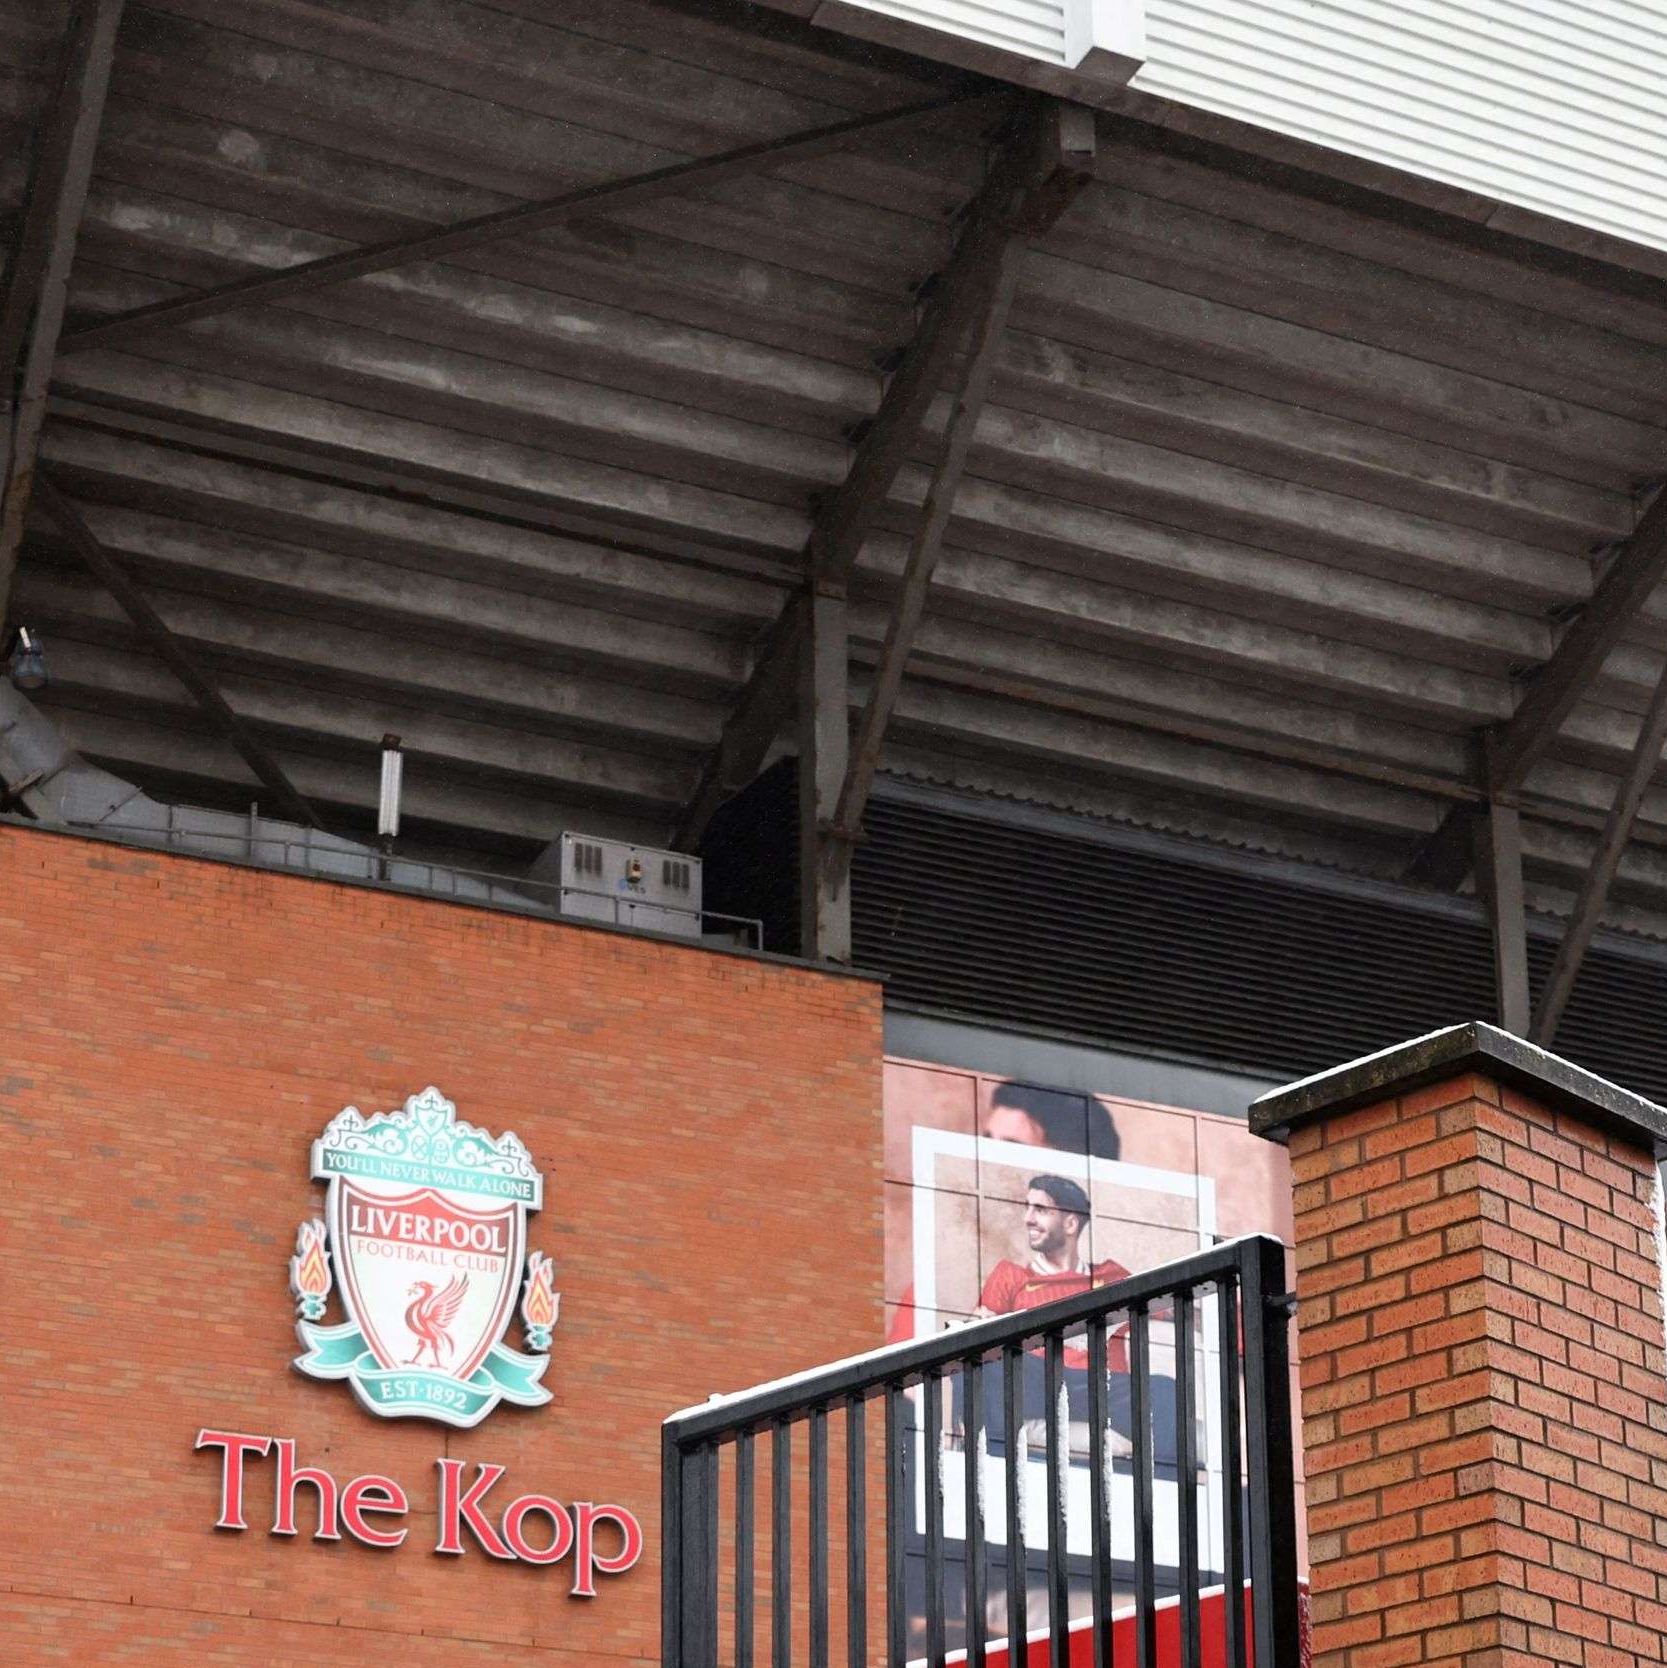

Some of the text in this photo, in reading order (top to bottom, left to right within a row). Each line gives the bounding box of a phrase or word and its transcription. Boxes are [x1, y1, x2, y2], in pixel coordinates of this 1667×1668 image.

[326, 1153, 532, 1198] YOU'LL NEVER WALK ALONE
[351, 1205, 507, 1253] LIVERPOOL
[357, 1240, 499, 1274] FOOTBALL CLUB
[195, 1428, 643, 1597] The Kop
